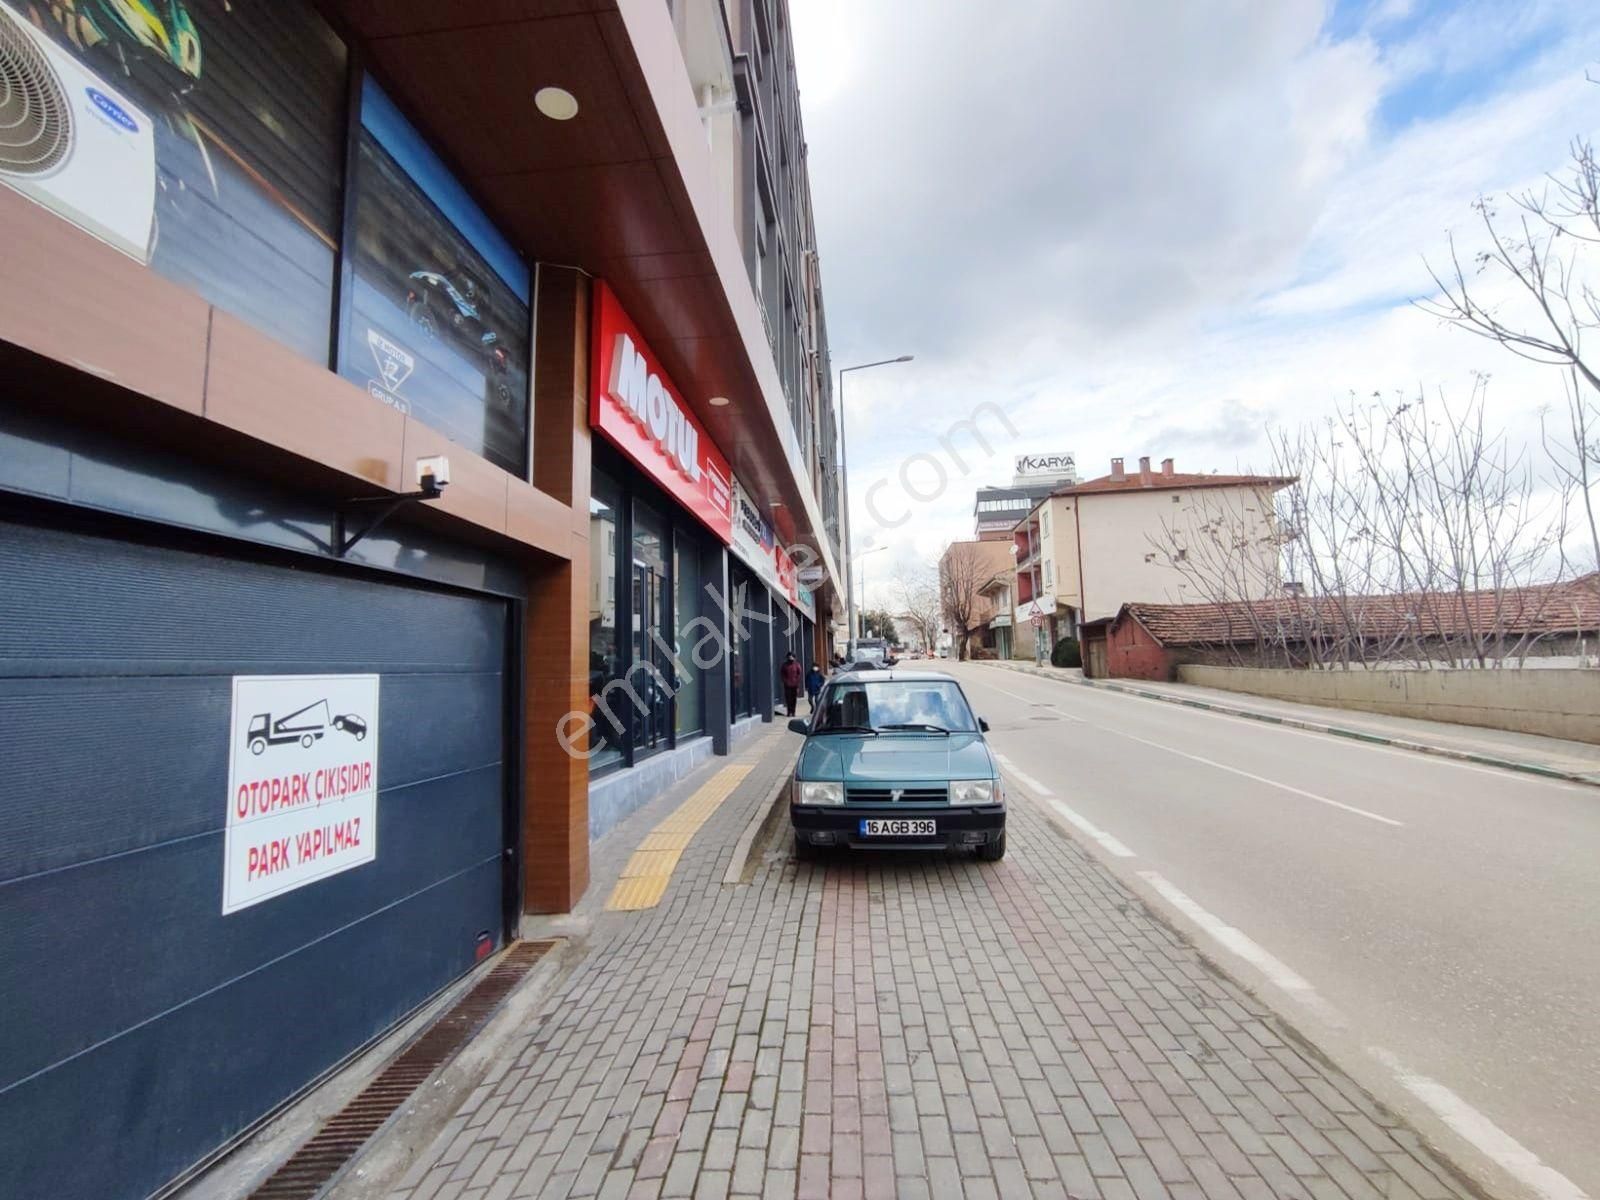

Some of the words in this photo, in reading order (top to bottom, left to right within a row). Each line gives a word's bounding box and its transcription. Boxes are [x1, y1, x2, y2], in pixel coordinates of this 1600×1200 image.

[92, 92, 135, 129] Carrier
[609, 333, 700, 483] MOTUL
[1027, 456, 1076, 469] KARYA
[236, 772, 310, 819] OTOPARK
[315, 762, 371, 808] ÇIKIŞIDIR
[247, 837, 291, 882] PARK
[296, 817, 361, 866] YAPILMAZ
[867, 821, 879, 833] 16
[881, 821, 909, 833] AGB
[911, 821, 935, 833] 396
